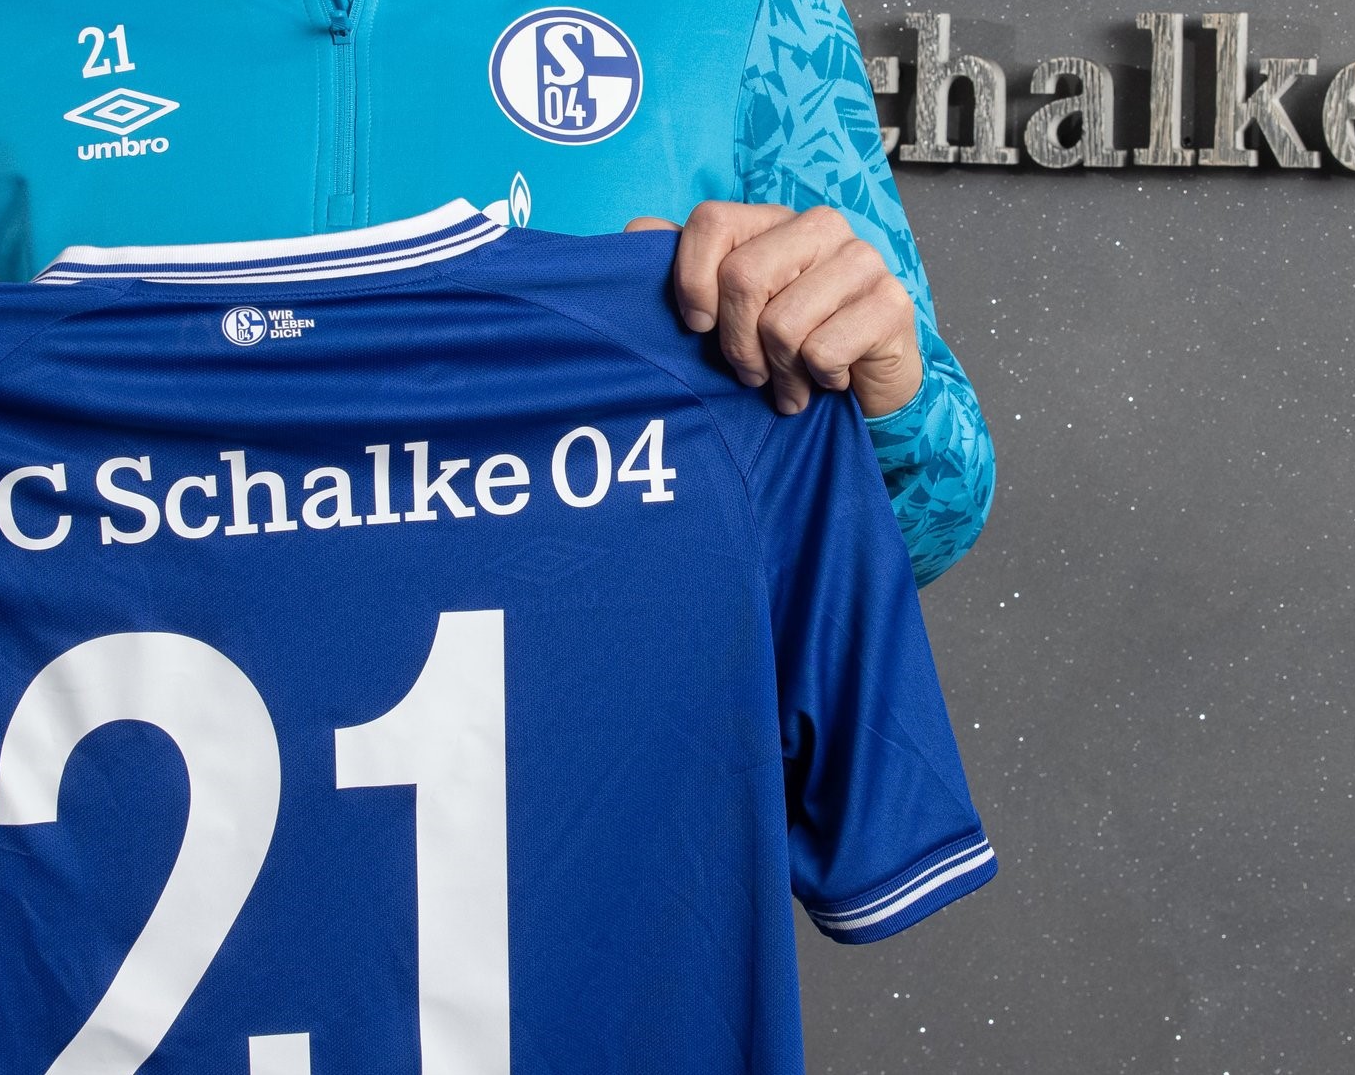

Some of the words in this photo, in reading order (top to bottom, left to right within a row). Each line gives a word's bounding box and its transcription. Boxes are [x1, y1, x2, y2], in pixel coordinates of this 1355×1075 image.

[77, 24, 136, 79] 21
[544, 86, 587, 127] 04
[77, 136, 170, 161] umbro
[268, 310, 294, 321] WIR
[274, 319, 315, 330] LEBEN
[270, 328, 302, 339] DICH
[94, 440, 531, 546] Schalke
[551, 419, 677, 509] 04
